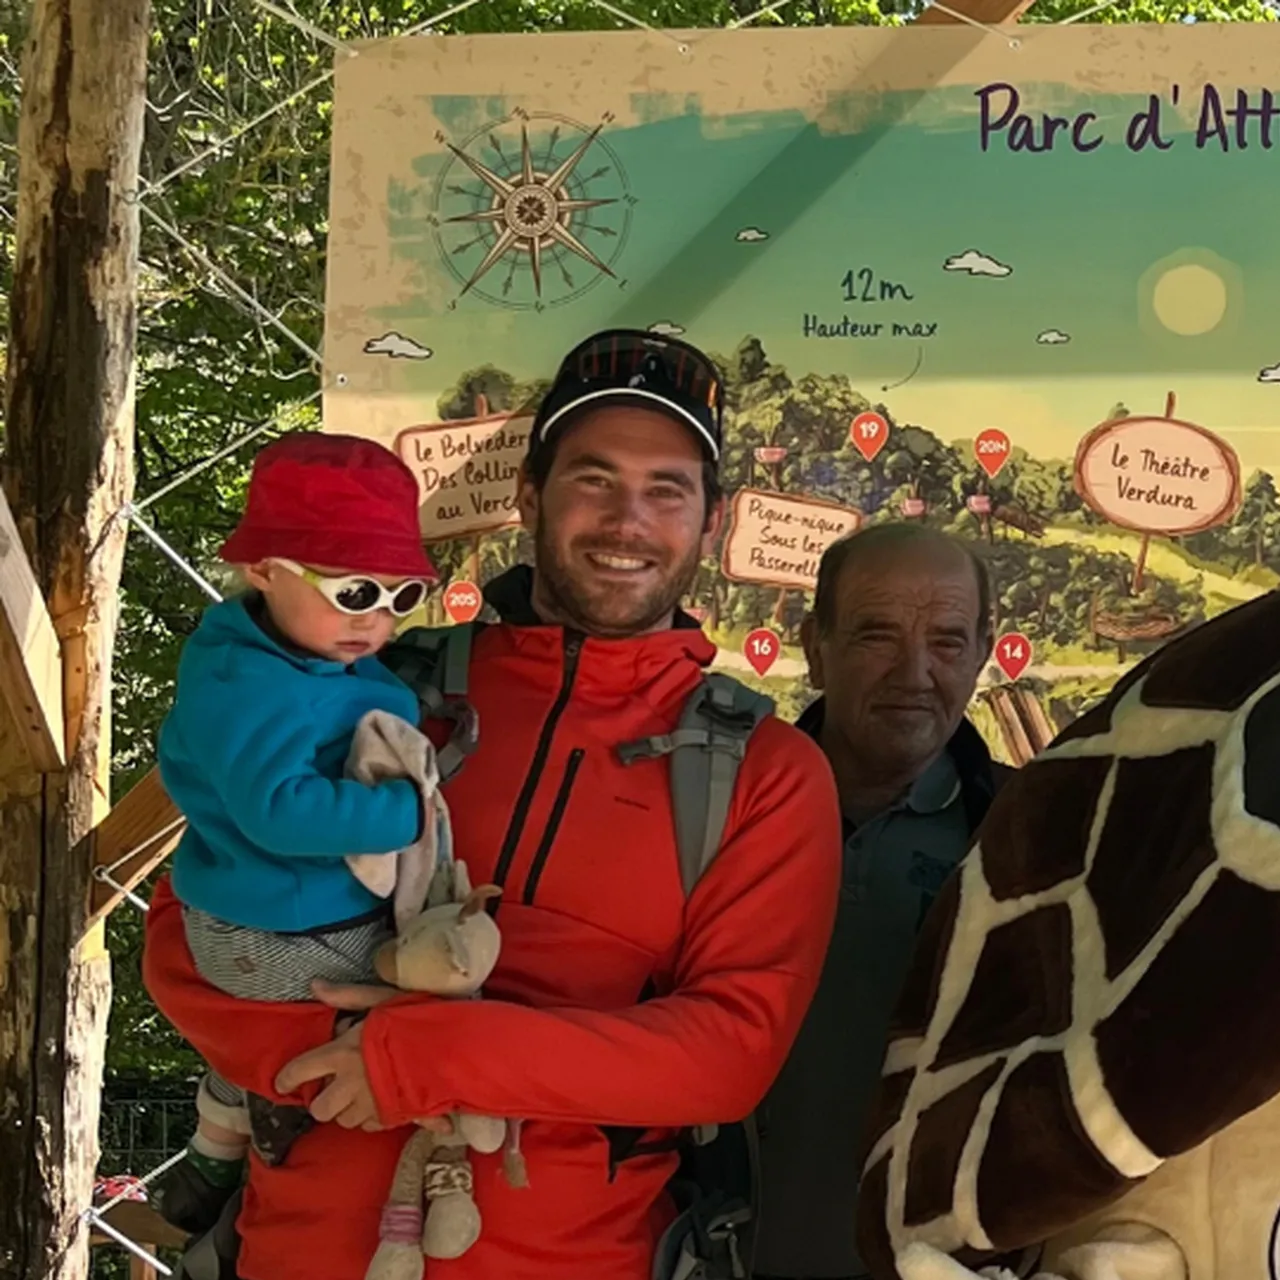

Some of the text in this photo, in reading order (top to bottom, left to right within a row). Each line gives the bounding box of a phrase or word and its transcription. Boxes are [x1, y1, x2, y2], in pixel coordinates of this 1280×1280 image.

[974, 82, 1104, 152] Parc
[840, 267, 914, 302] 12m
[803, 313, 938, 338] Hauteur max
[440, 430, 528, 458] Belvédèr
[859, 421, 880, 439] 19
[422, 460, 519, 492] Des Collin
[1117, 476, 1198, 511] Verdura
[436, 505, 465, 521] au
[748, 498, 845, 535] Pique-nique
[759, 525, 798, 550] Sous
[748, 546, 817, 578] Passerell
[751, 639, 772, 656] 16
[1003, 642, 1024, 659] 14
